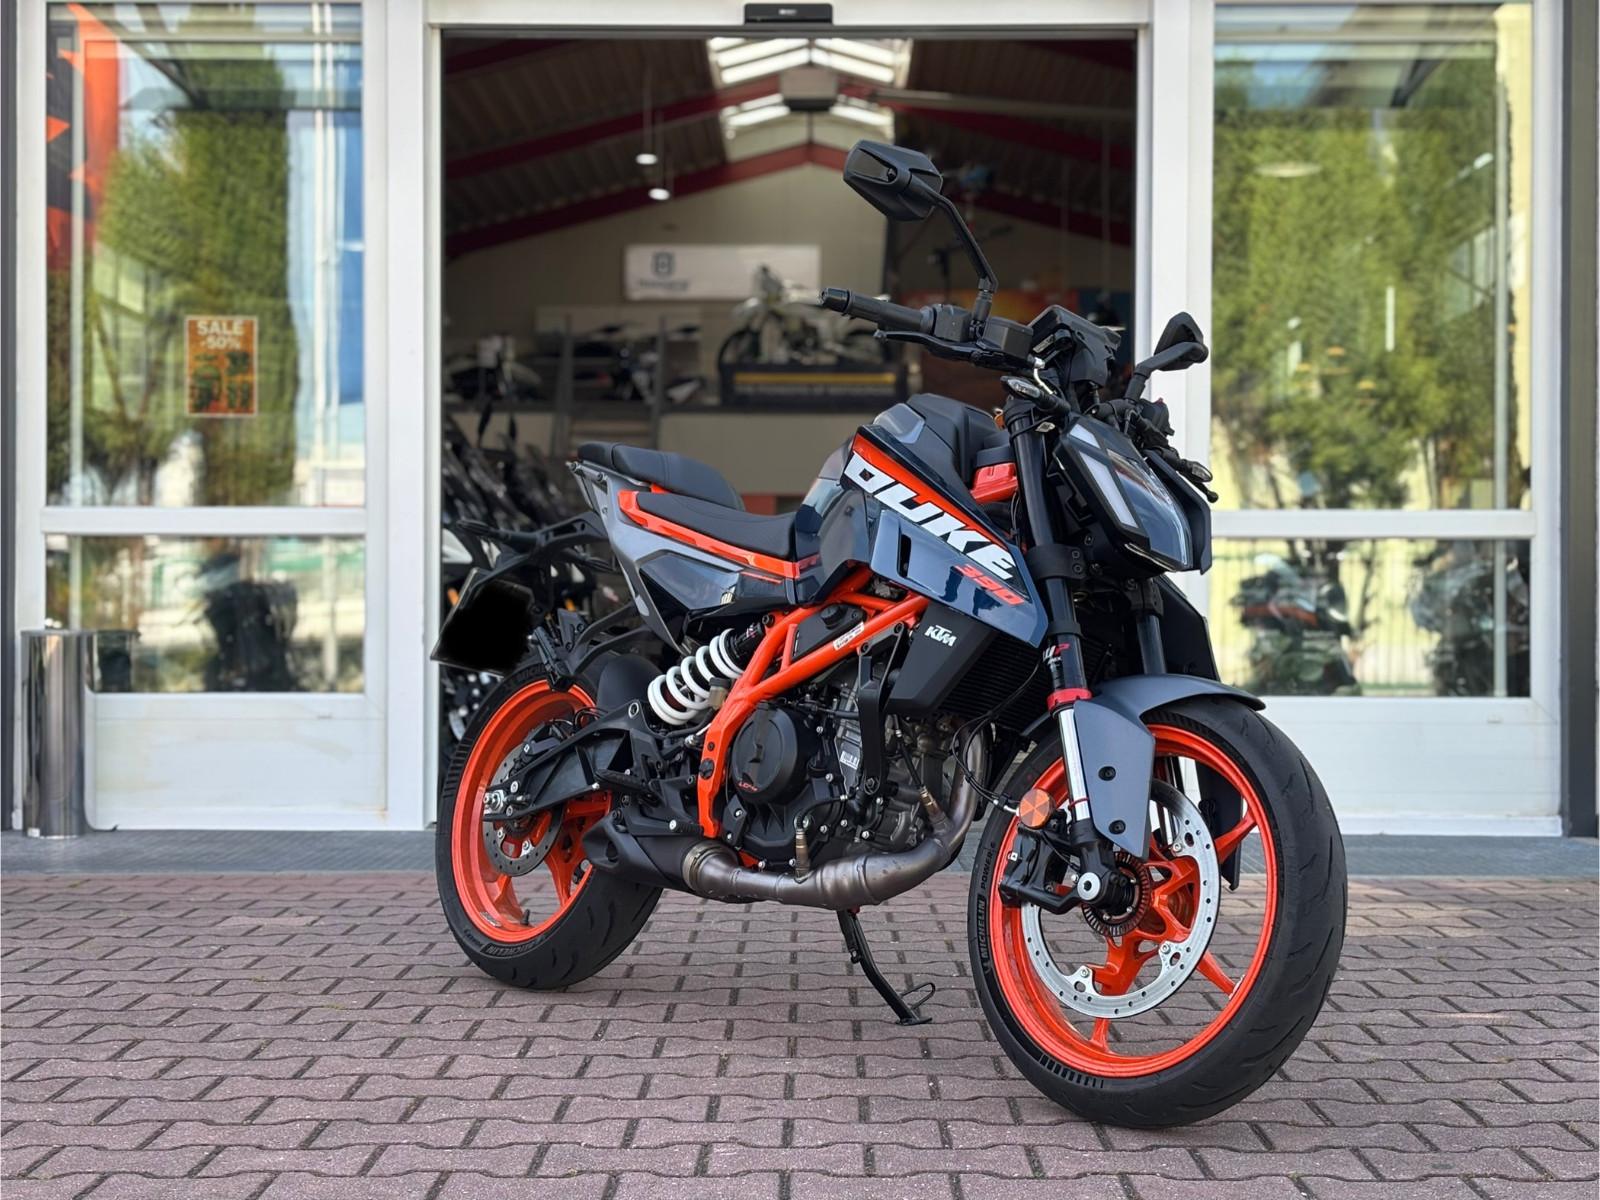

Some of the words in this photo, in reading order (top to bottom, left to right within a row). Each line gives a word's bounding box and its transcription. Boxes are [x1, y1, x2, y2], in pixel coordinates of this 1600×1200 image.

[197, 320, 245, 336] SALE
[844, 451, 1017, 581] DUKE
[954, 563, 1025, 606] 390
[924, 624, 958, 647] KTM
[980, 851, 993, 890] POWER
[977, 899, 989, 959] MICHELIN
